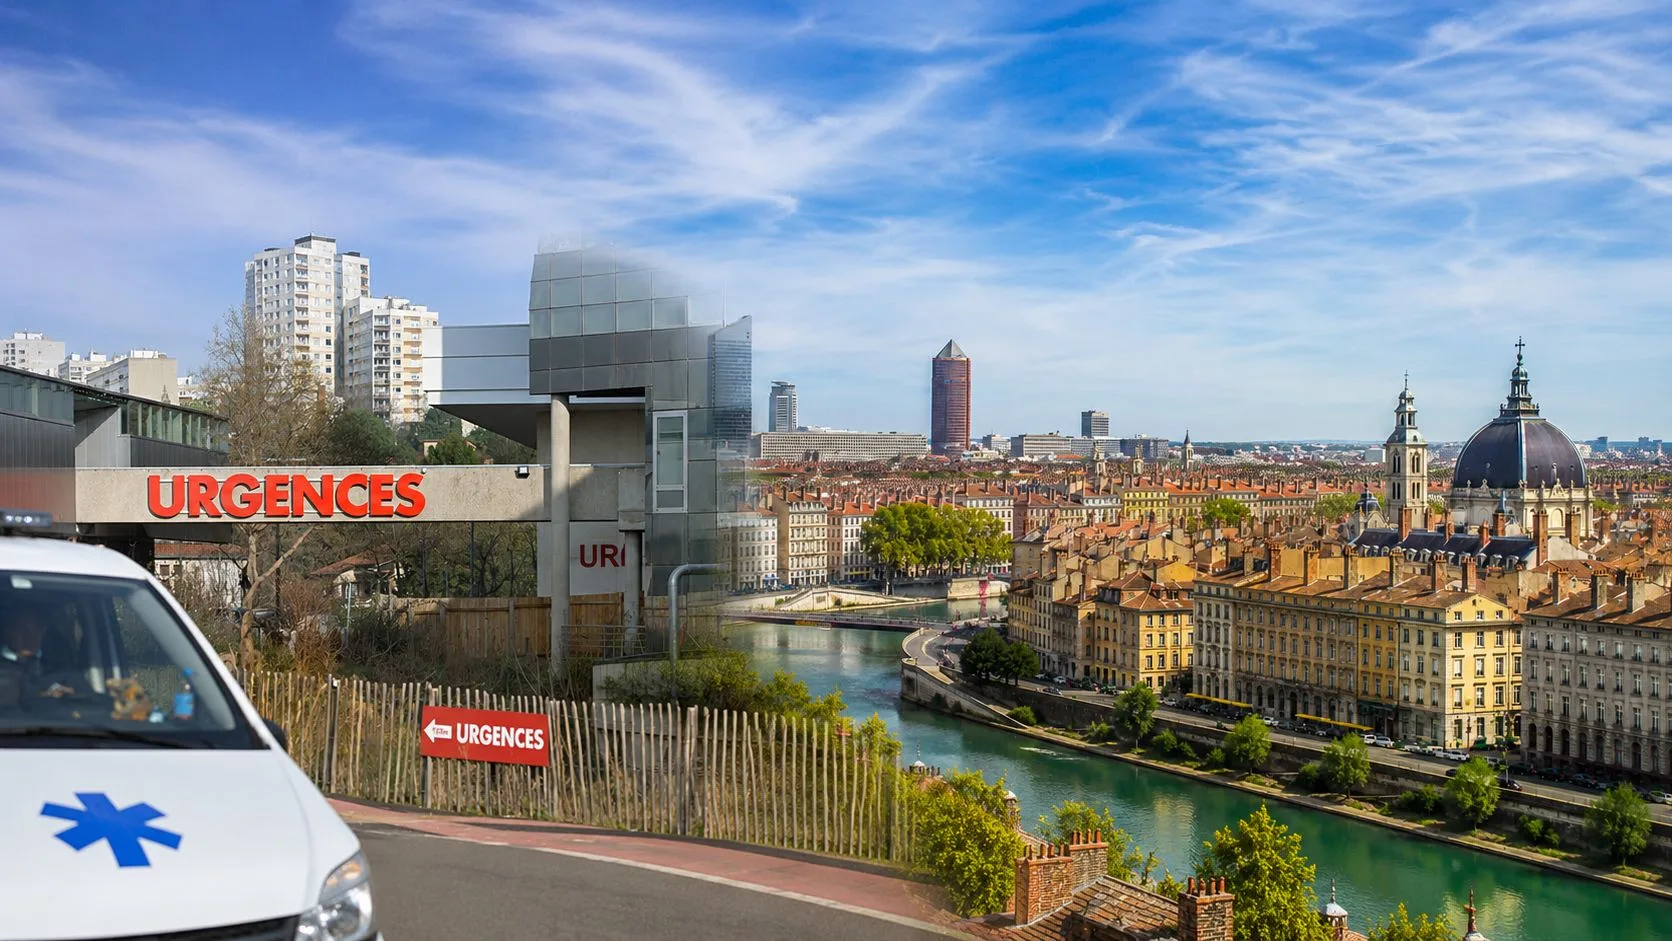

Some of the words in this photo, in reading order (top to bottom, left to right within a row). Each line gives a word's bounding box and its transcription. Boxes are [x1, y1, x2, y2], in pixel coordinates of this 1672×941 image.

[147, 473, 426, 518] URGENCES
[579, 544, 626, 568] UR
[456, 722, 544, 750] URGENCES
